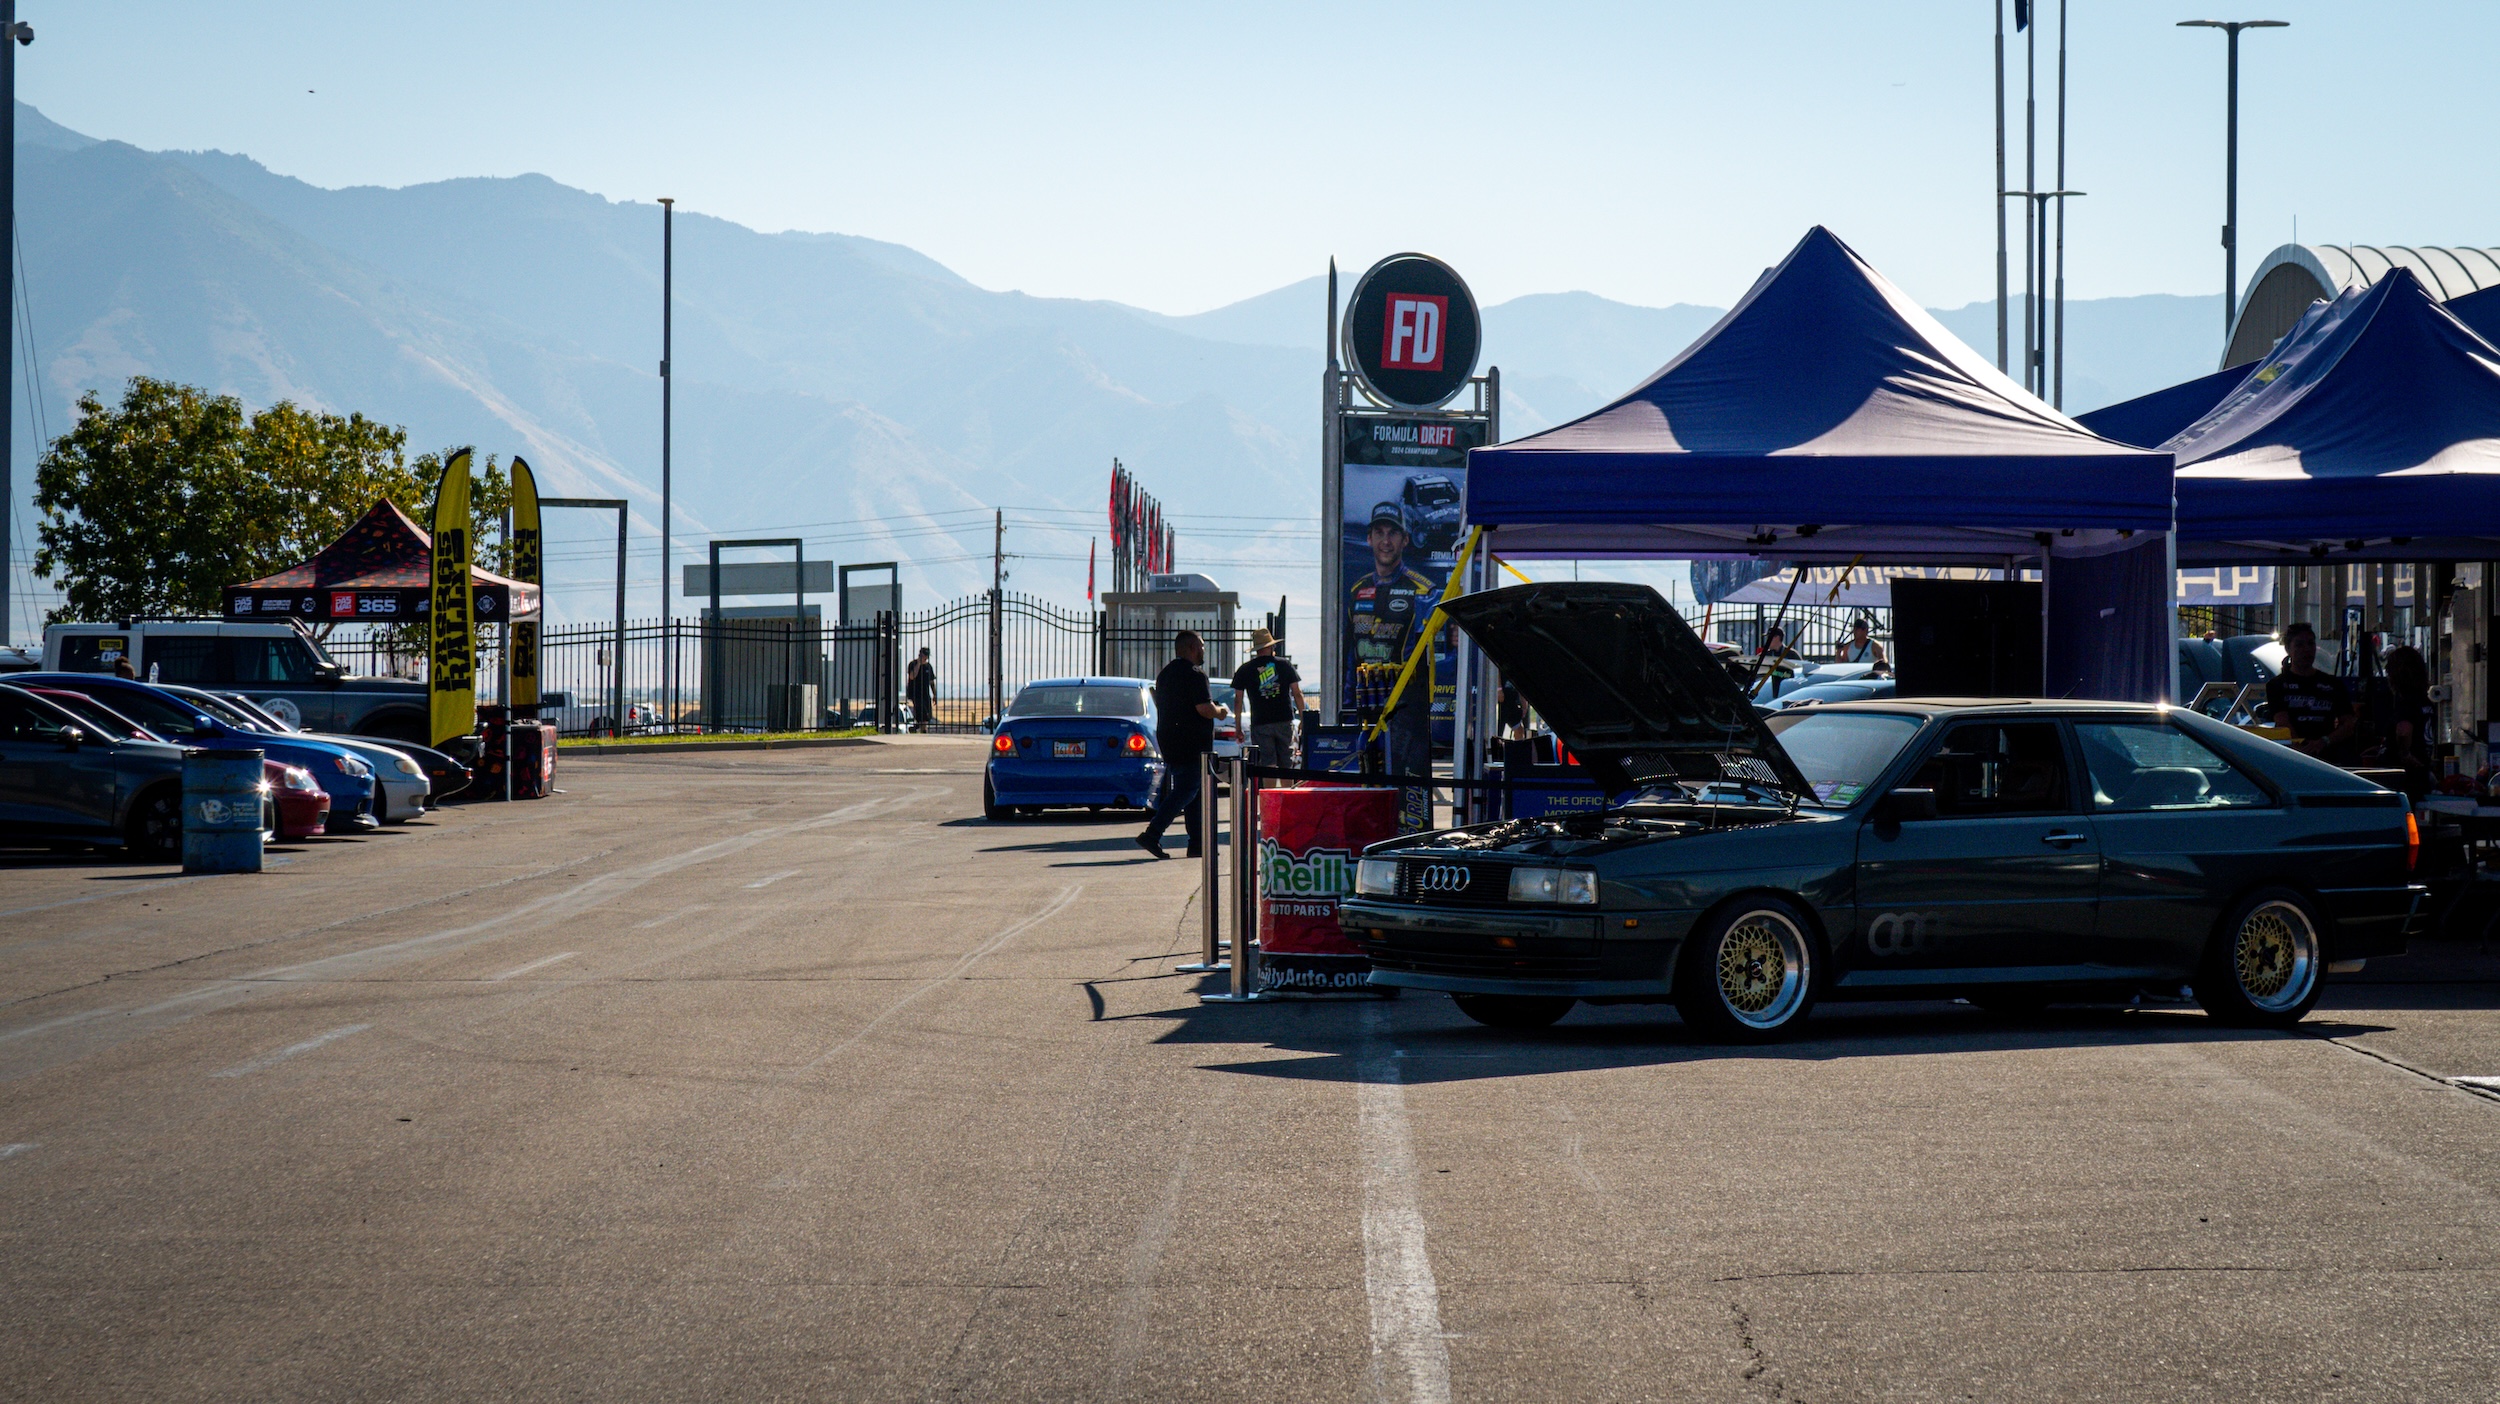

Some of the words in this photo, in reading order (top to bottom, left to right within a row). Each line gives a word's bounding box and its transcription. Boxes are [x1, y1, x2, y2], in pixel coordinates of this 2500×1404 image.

[1390, 300, 1440, 364] FD
[1373, 425, 1418, 443] FORMULA
[1420, 426, 1454, 446] DRIFT
[1391, 446, 1404, 454] 2024
[1405, 447, 1438, 455] CHAMPIONSHIP
[1406, 570, 1432, 586] momo
[358, 599, 397, 613] 365
[446, 570, 471, 691] RALLY
[1547, 796, 1569, 806] THE
[1260, 847, 1358, 899] O'Reilly
[1270, 904, 1291, 915] AUTO
[1293, 905, 1331, 917] PARTS
[1258, 966, 1374, 989] eillyAuto.com
